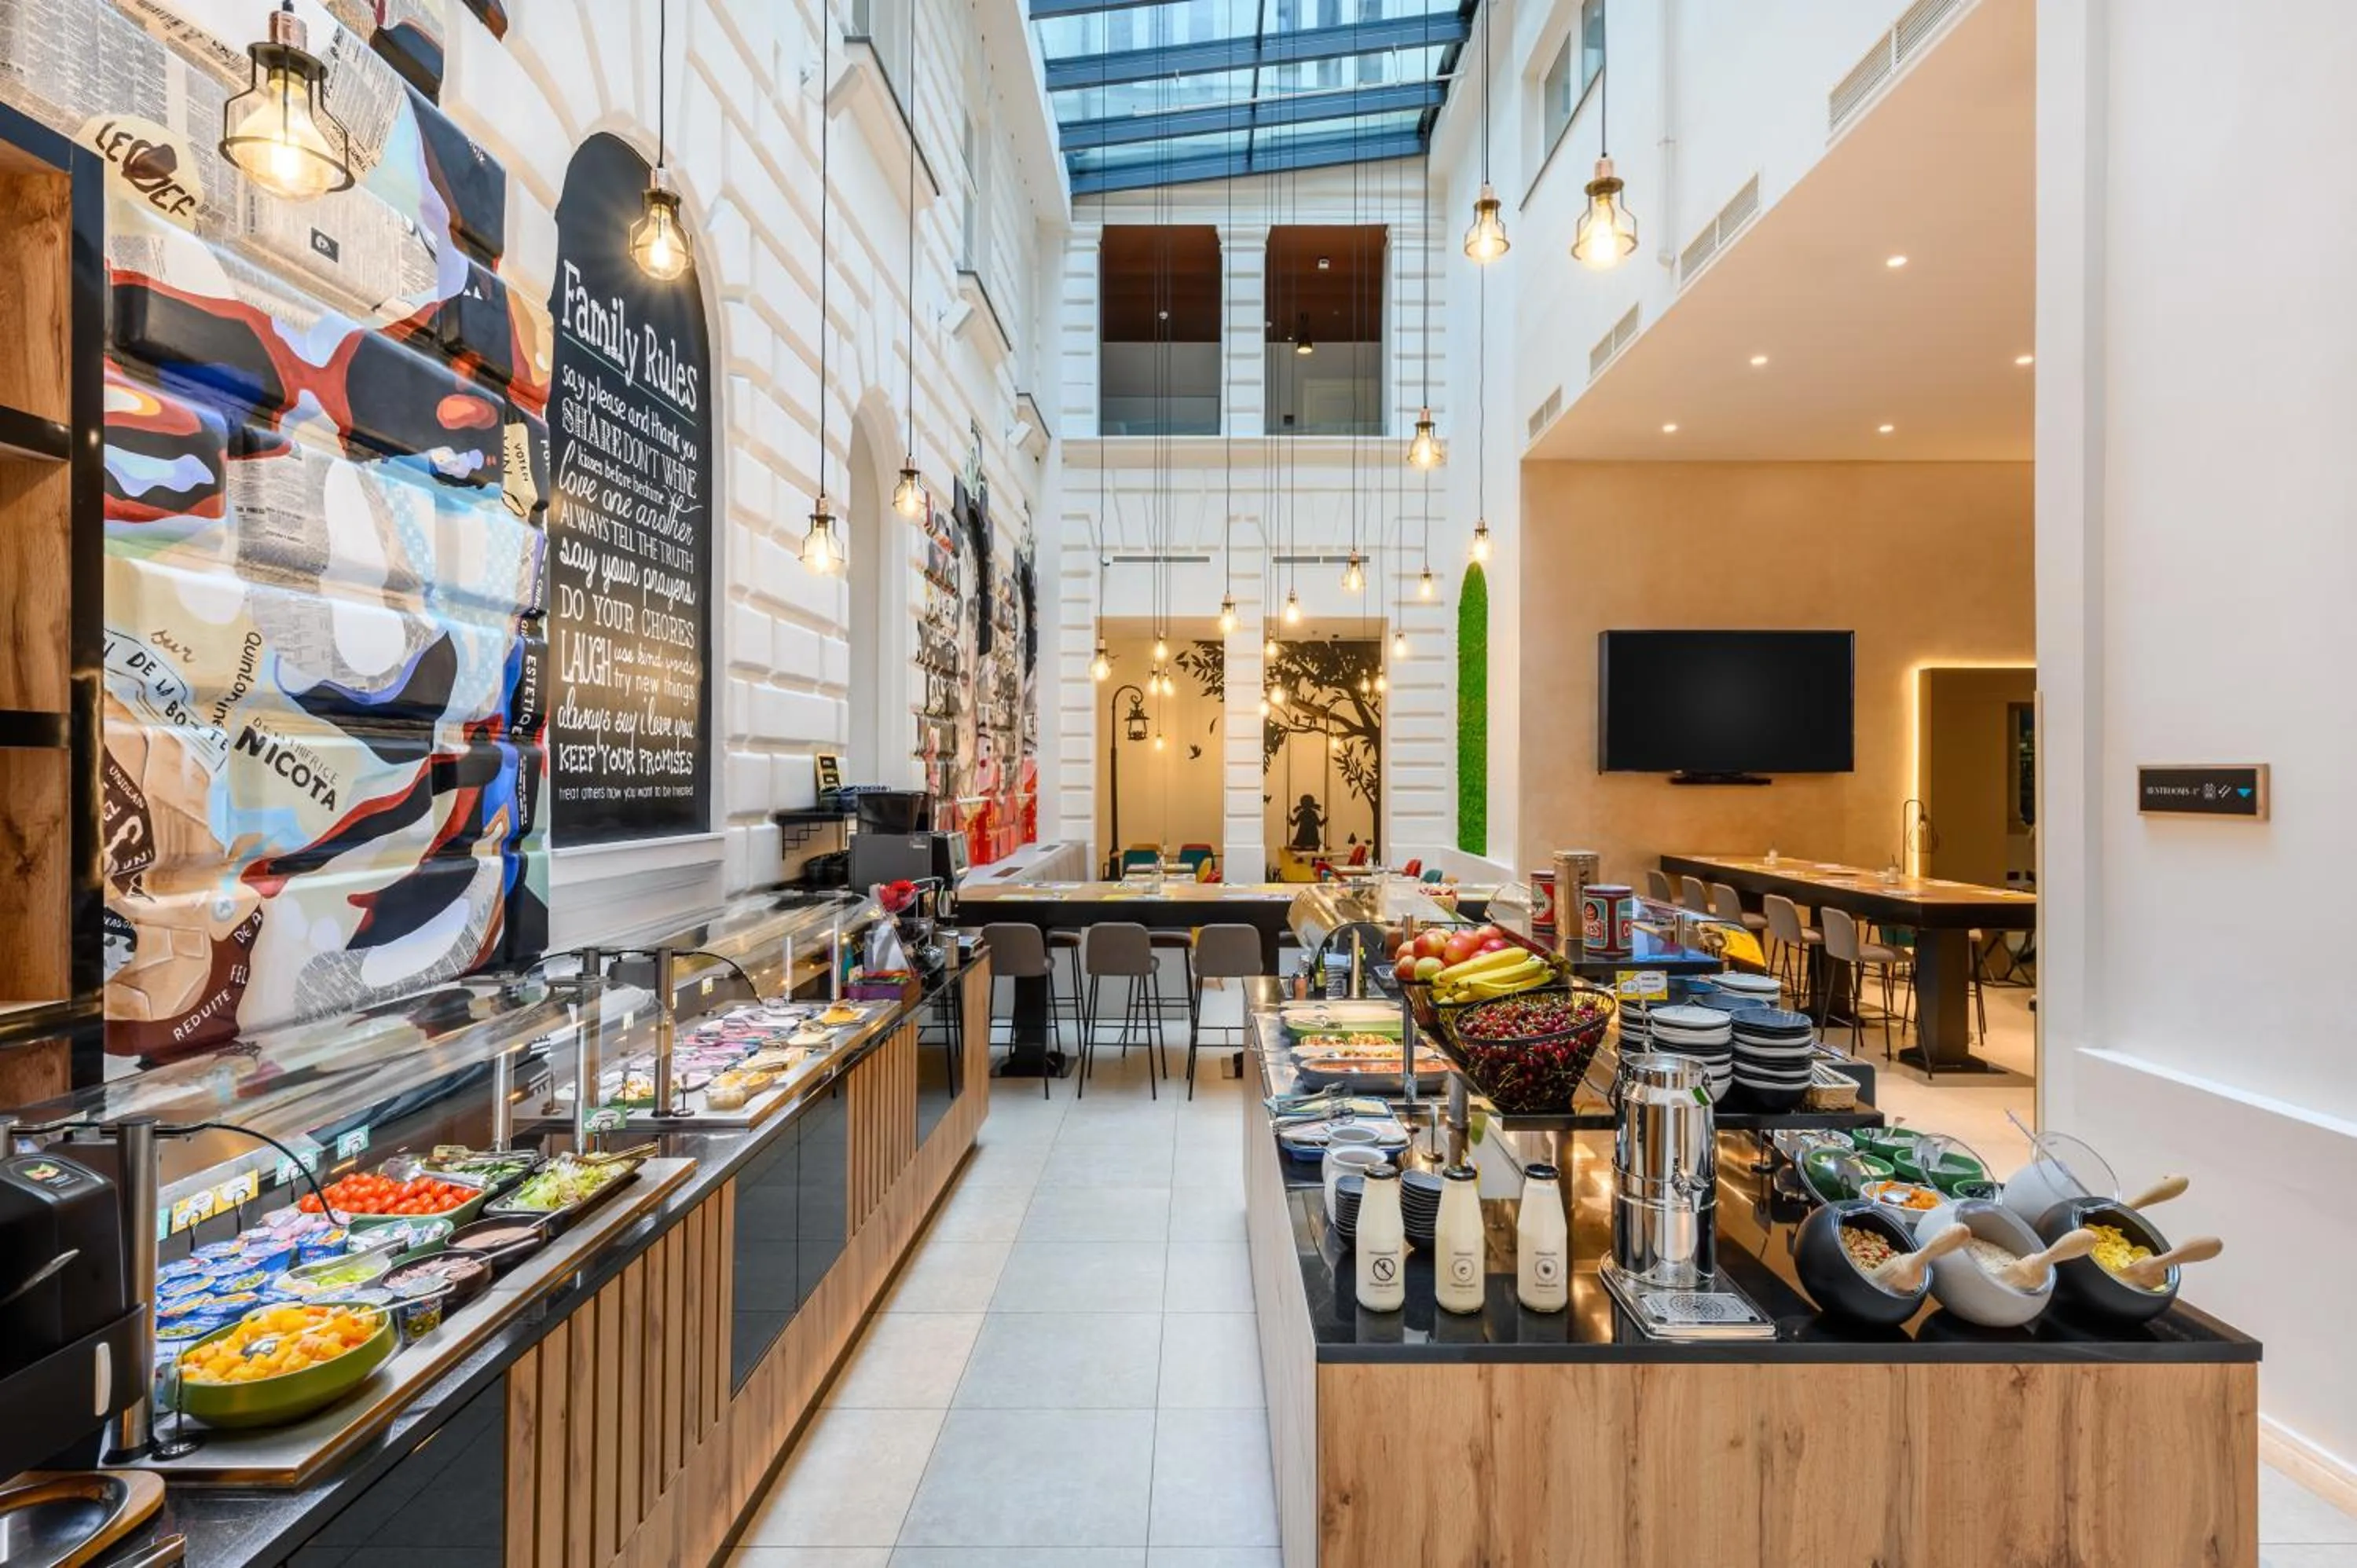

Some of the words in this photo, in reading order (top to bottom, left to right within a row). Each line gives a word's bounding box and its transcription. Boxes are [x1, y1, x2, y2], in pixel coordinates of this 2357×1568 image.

[562, 259, 639, 387] Family
[644, 323, 698, 412] Rules
[562, 365, 586, 401] say
[588, 375, 626, 421] please
[629, 405, 649, 437] and
[651, 411, 679, 454] thank
[680, 438, 697, 462] you
[562, 397, 621, 460] SHARE
[662, 452, 698, 500] WHINE
[604, 459, 632, 489] before
[560, 500, 610, 543] ALWAYS
[610, 518, 636, 552] TELL
[636, 530, 658, 560] THE
[658, 540, 694, 575] TRUTH
[602, 489, 632, 518] one
[636, 486, 698, 546] another
[559, 537, 598, 589] say
[601, 553, 640, 595] your
[642, 567, 695, 613] prayers
[559, 584, 585, 621] DO
[592, 593, 636, 636] YOUR
[641, 608, 695, 650] CHORES
[126, 650, 157, 677] DE
[561, 629, 612, 687] LAUGH
[614, 646, 634, 664] use
[637, 641, 662, 668] kind
[614, 666, 632, 698] try
[635, 673, 659, 693] new
[664, 670, 695, 707] things
[557, 685, 611, 753] always
[614, 709, 638, 756] say
[647, 696, 672, 737] love
[674, 714, 695, 749] you
[234, 724, 337, 812] NICOTA
[559, 742, 596, 774] KEEP
[599, 744, 636, 776] YOUR
[639, 746, 695, 776] PROMISES
[172, 988, 232, 1042] REDUITE
